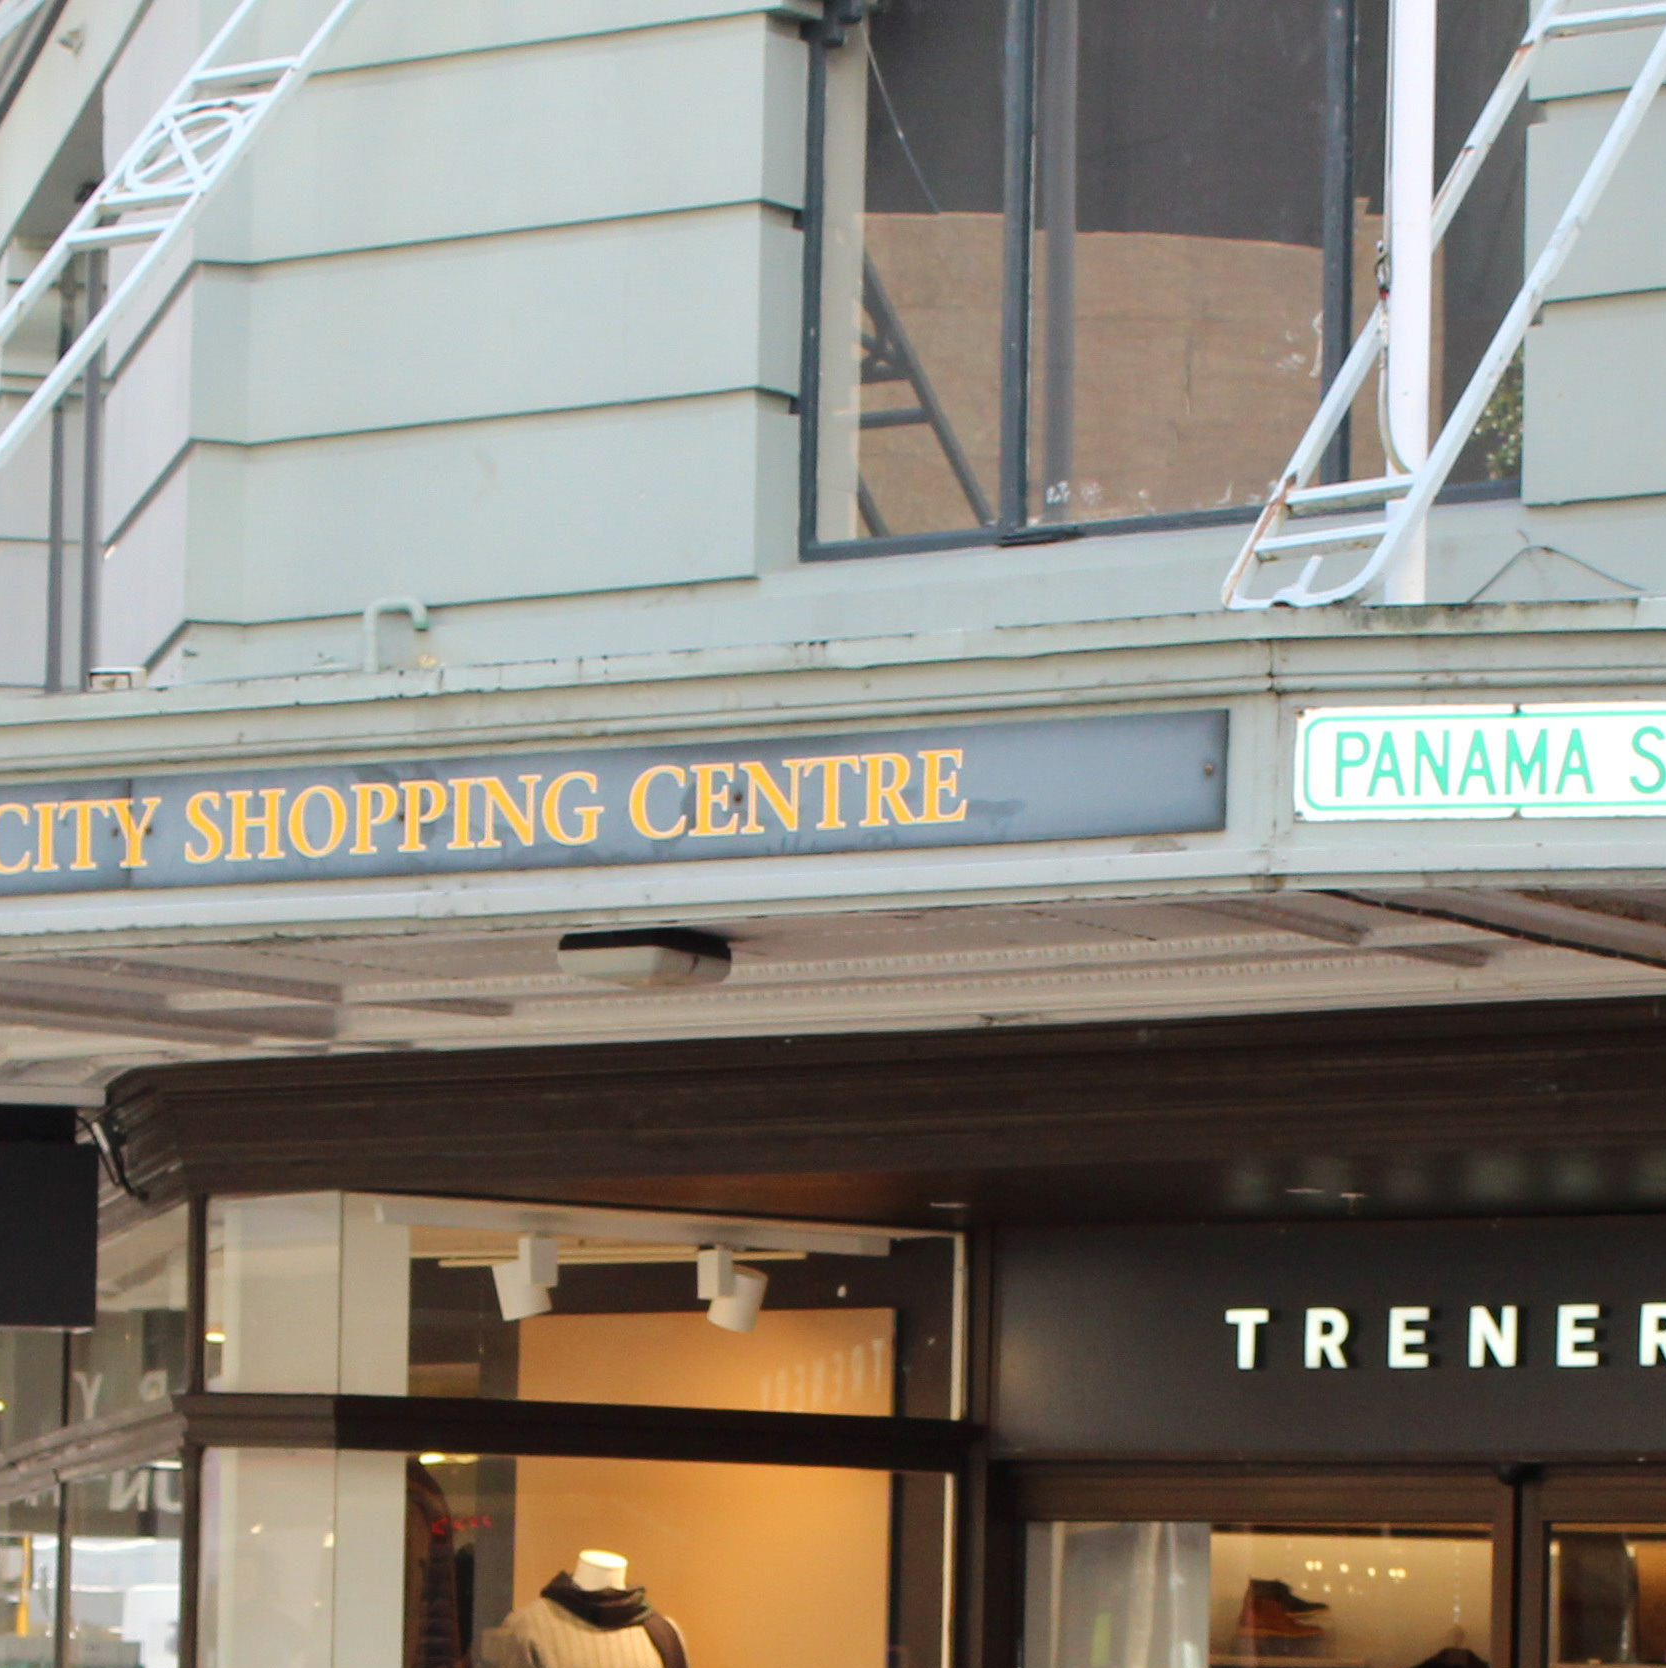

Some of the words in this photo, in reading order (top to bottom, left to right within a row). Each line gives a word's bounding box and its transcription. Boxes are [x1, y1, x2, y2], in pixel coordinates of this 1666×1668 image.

[184, 770, 603, 864] SHOPPING
[628, 748, 969, 840] CENTRE
[1335, 728, 1594, 797] PANAMA
